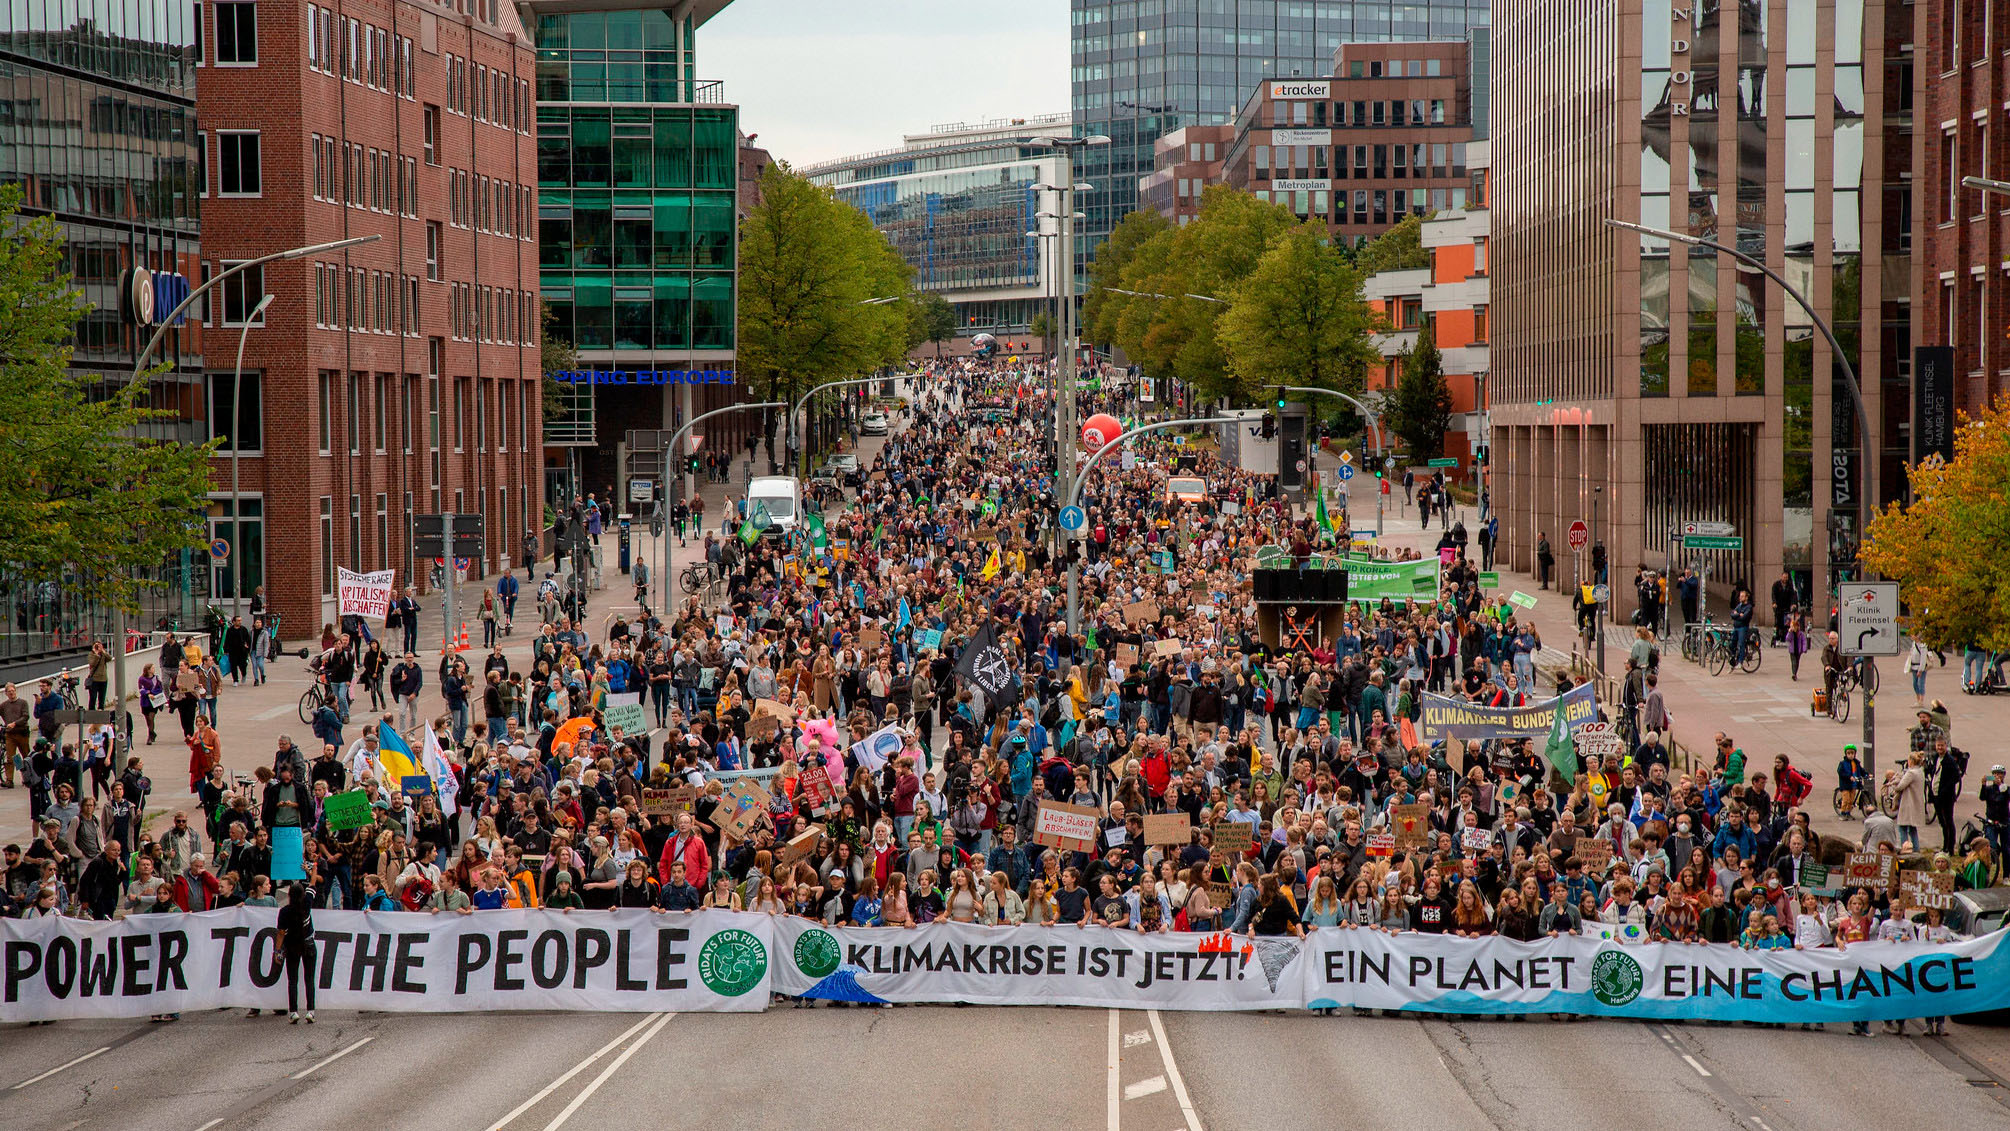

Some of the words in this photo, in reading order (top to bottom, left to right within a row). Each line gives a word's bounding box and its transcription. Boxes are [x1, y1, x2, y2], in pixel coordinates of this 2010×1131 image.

[1274, 84, 1327, 96] etracker
[1278, 181, 1326, 190] Metroplan
[636, 370, 734, 385] EUROPE
[1925, 360, 1934, 415] FLEETINSEL
[1935, 396, 1945, 446] HAMBURG
[1925, 416, 1934, 446] KLINIK
[1570, 530, 1586, 543] STOP
[1857, 606, 1881, 614] Klinik
[1848, 616, 1890, 624] Fleetinsel
[1580, 743, 1617, 756] JETZT
[801, 768, 826, 780] 23.09.
[643, 791, 669, 799] KLIMA
[644, 798, 662, 806] BIER
[1578, 840, 1606, 849] FOSSILE
[1850, 854, 1877, 865] KEIN
[1846, 878, 1866, 886] WIR
[1866, 878, 1889, 887] SIND
[1913, 892, 1952, 908] FLUT
[795, 935, 808, 967] FRIDAYS
[808, 930, 821, 938] FOR
[822, 933, 840, 958] FUTURE
[4, 930, 189, 1003] POWER
[211, 927, 285, 989] TO
[314, 930, 430, 993] THE
[454, 928, 690, 995] PEOPLE
[701, 940, 718, 984] FRIDAYS
[717, 931, 738, 944] FOR
[740, 933, 765, 965] FUTURE
[847, 942, 1066, 976] KLIMAKRISE
[1077, 946, 1133, 978] IST
[1134, 948, 1251, 989] JETZT!
[1324, 950, 1391, 986] EIN
[1408, 956, 1575, 991] PLANET
[1592, 959, 1602, 995] FRIDAYS
[1600, 952, 1618, 962] FOR
[1619, 954, 1641, 982] FUTURE
[1663, 965, 1764, 1000] EINE
[1780, 956, 1977, 1002] CHANCE
[1610, 987, 1639, 1004] Hamburg
